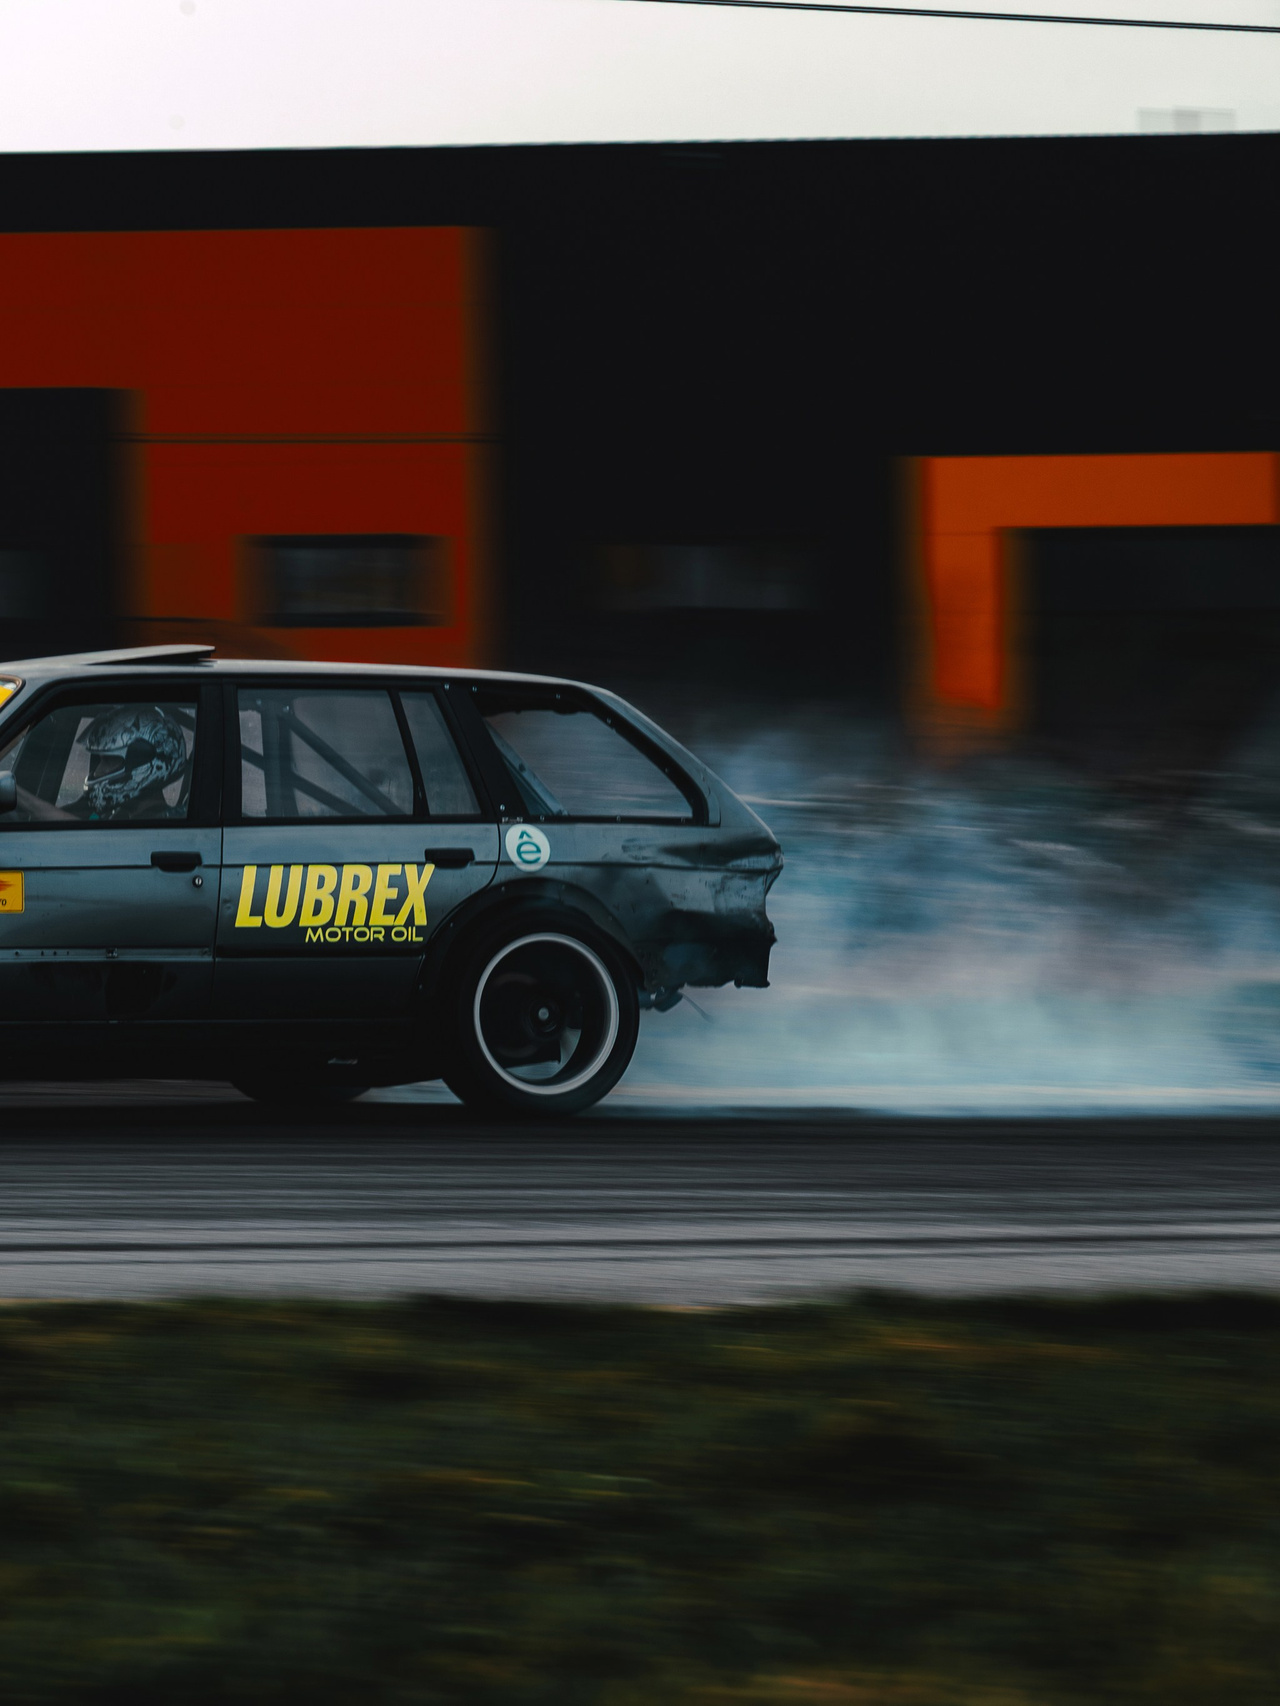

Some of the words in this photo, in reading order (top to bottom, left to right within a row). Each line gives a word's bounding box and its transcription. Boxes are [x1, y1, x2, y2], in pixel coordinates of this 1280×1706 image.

[235, 863, 435, 928] LUBREX
[305, 927, 385, 943] MOTOR
[391, 926, 424, 942] OIL
